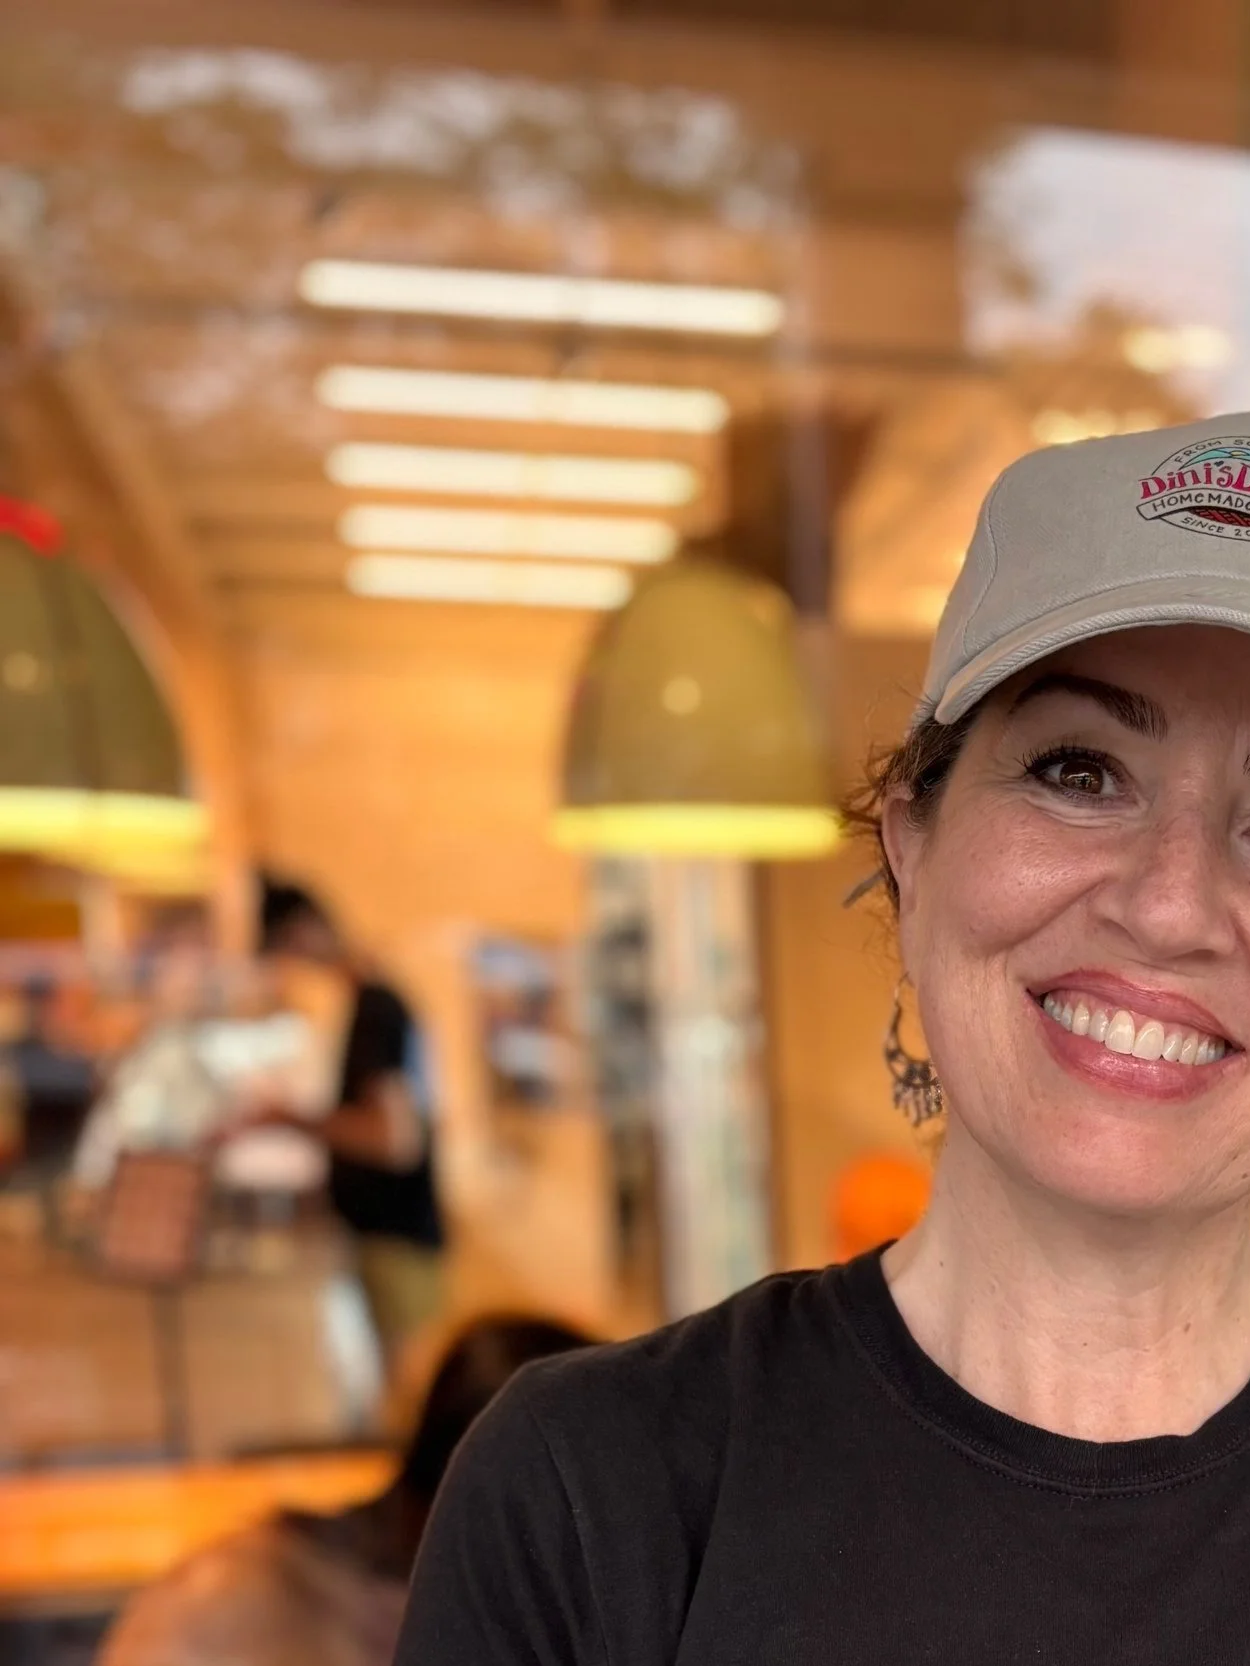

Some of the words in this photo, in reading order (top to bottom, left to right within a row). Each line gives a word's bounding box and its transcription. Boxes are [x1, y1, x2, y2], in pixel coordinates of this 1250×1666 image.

[1174, 440, 1223, 464] FROM
[1138, 460, 1234, 499] Dini's
[1181, 517, 1225, 533] SINCE
